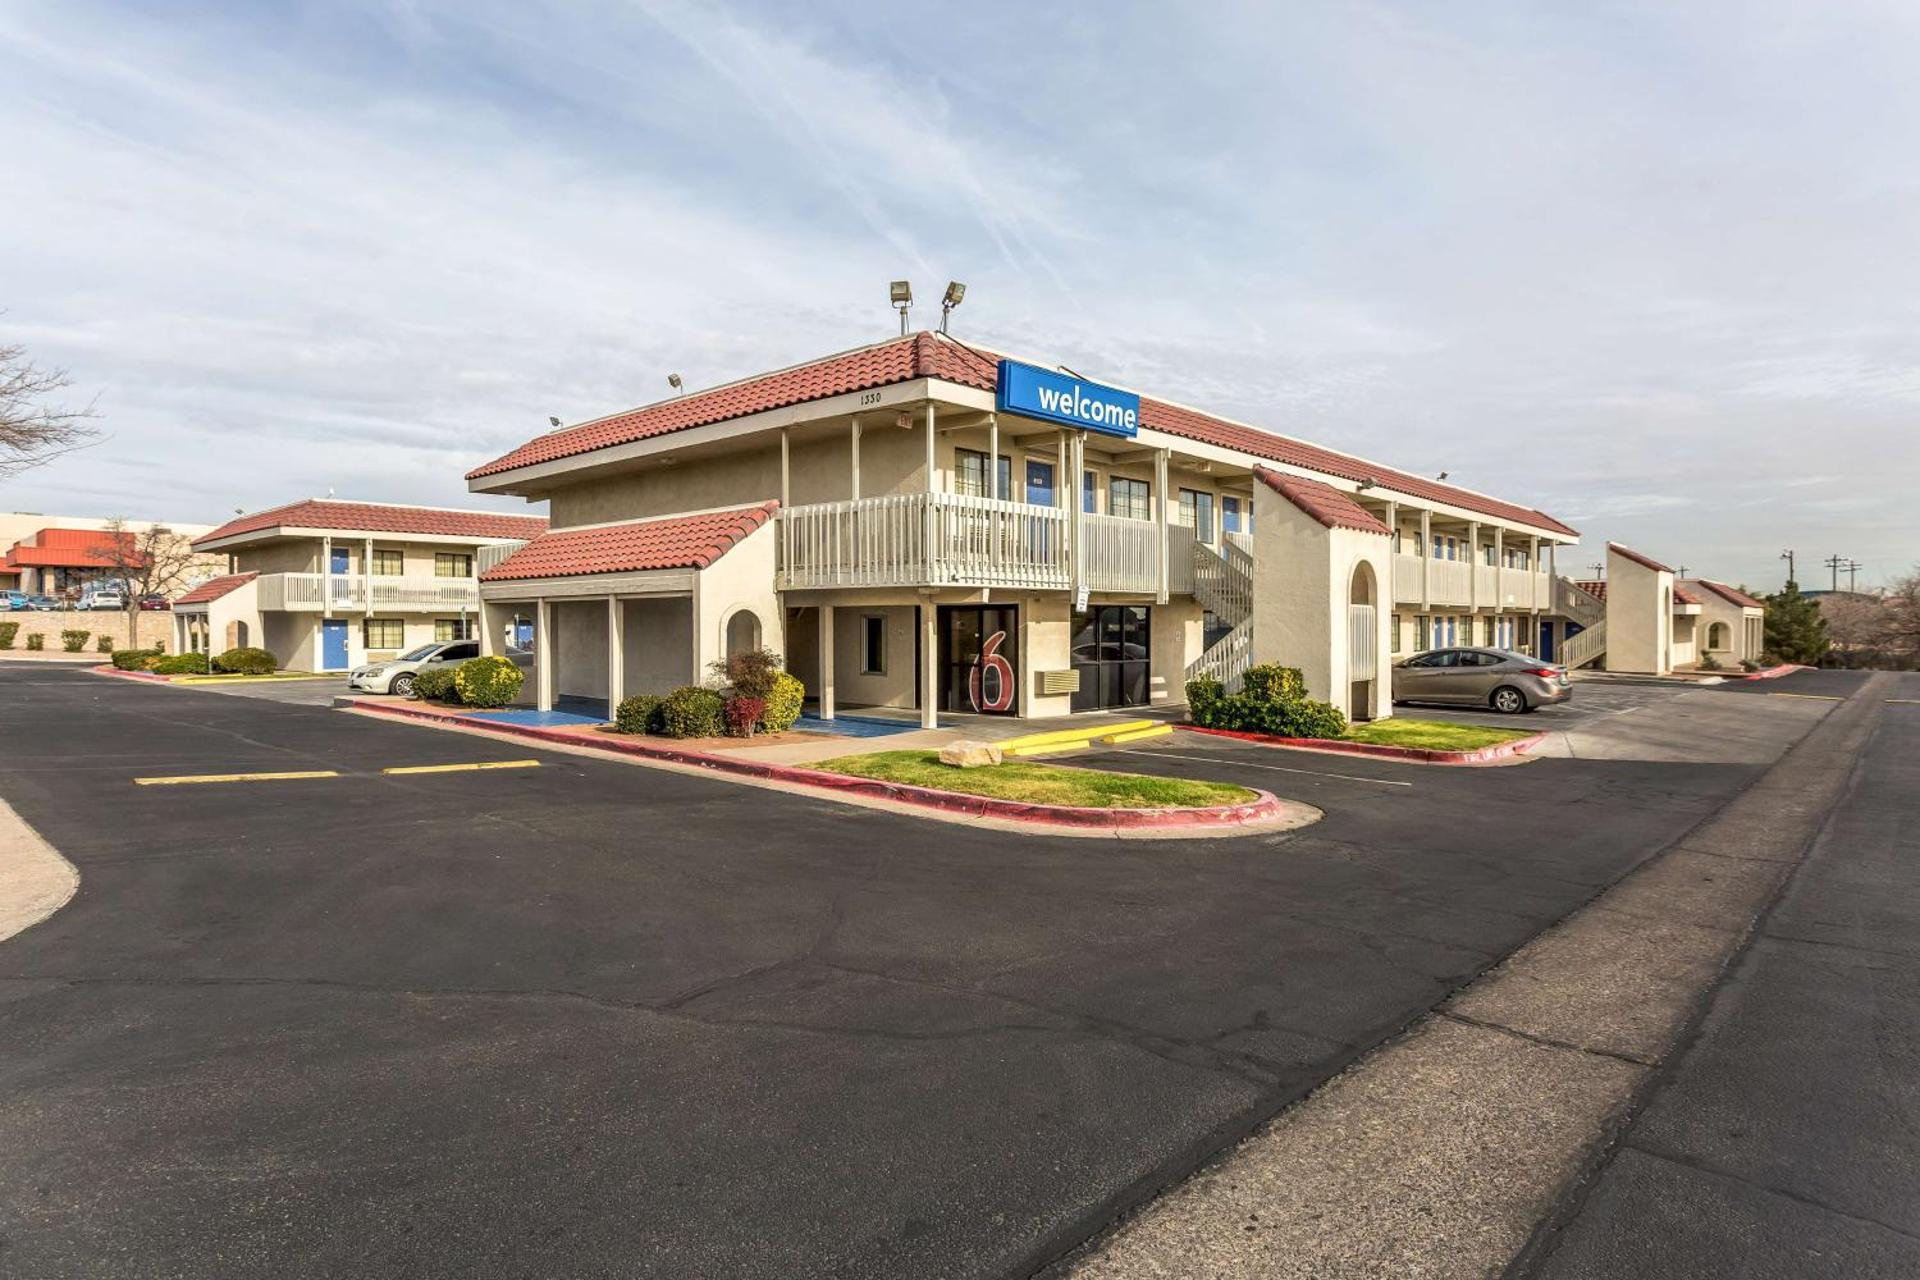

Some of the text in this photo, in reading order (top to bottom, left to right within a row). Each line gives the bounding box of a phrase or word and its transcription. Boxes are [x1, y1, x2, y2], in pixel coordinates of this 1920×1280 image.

[861, 392, 881, 406] 1330
[1038, 384, 1136, 430] welcome
[968, 631, 1015, 712] 6
